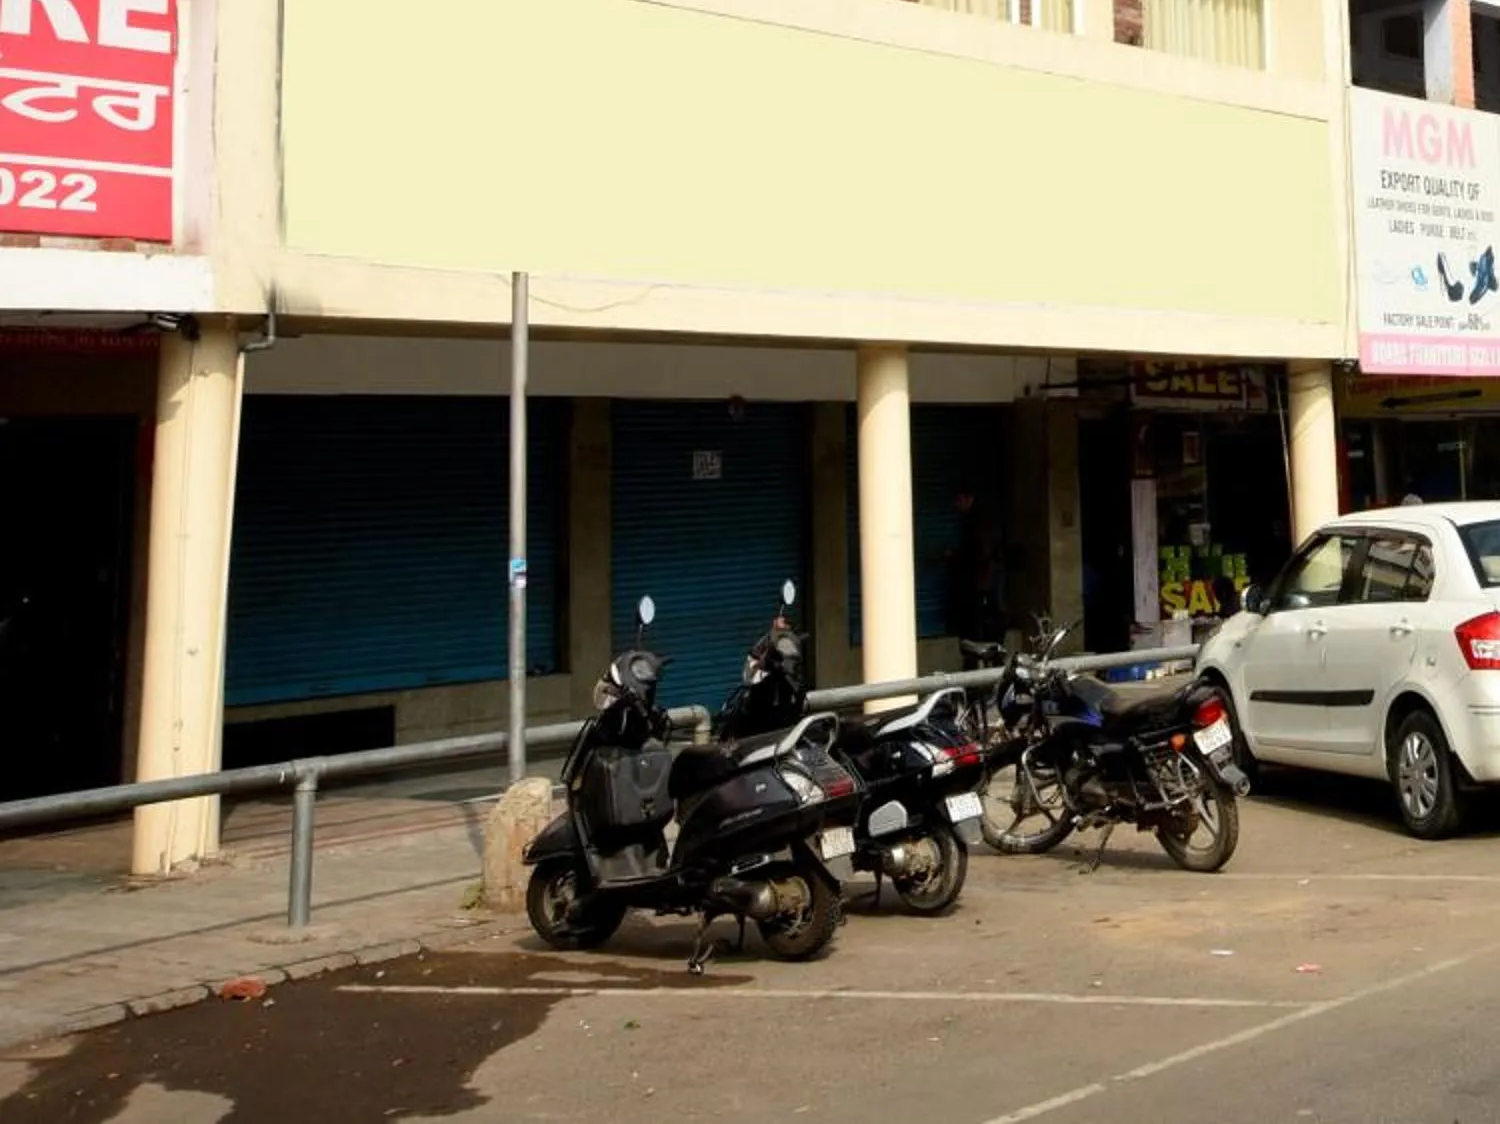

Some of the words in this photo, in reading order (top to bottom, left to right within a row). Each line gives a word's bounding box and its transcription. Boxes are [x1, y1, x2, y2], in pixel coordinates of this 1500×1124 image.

[1382, 105, 1478, 169] MGM
[1380, 169, 1421, 193] EXPORT
[1423, 175, 1465, 200] QUALITY
[1467, 181, 1480, 201] OF
